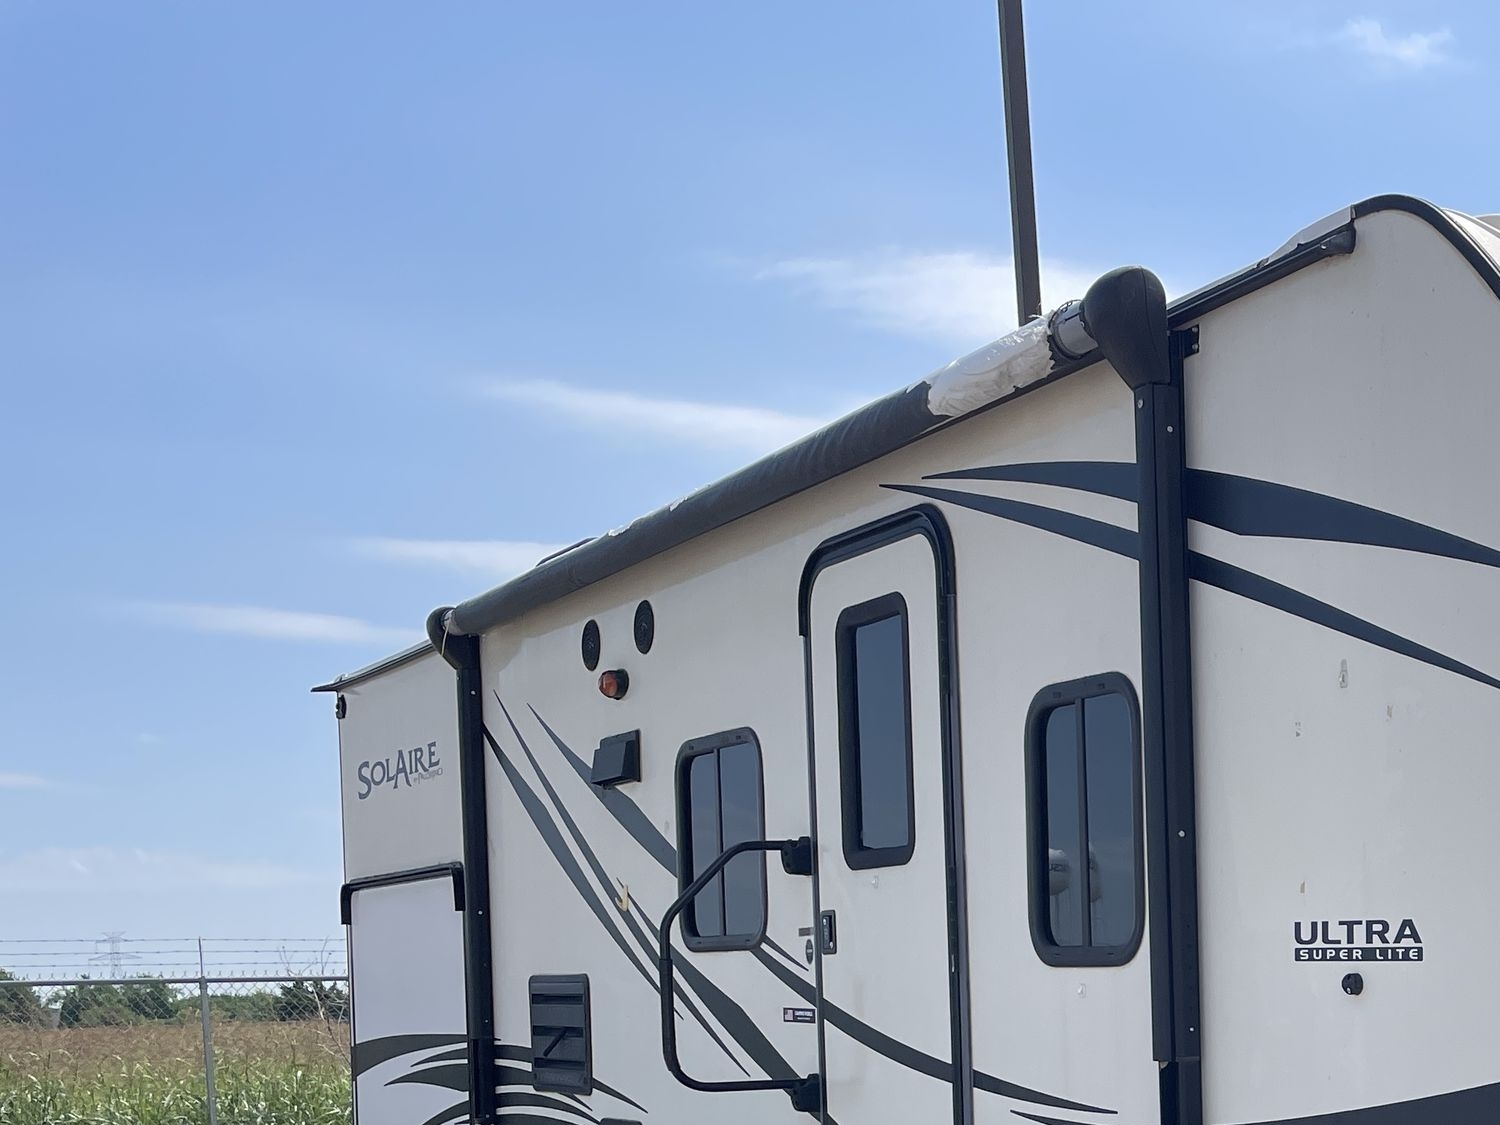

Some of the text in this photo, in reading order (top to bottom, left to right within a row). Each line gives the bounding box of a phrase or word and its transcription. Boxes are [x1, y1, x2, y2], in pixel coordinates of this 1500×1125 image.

[357, 741, 441, 800] SOLAIRE
[1294, 918, 1423, 945] ULTRA
[1299, 948, 1419, 960] SUPER LITE
